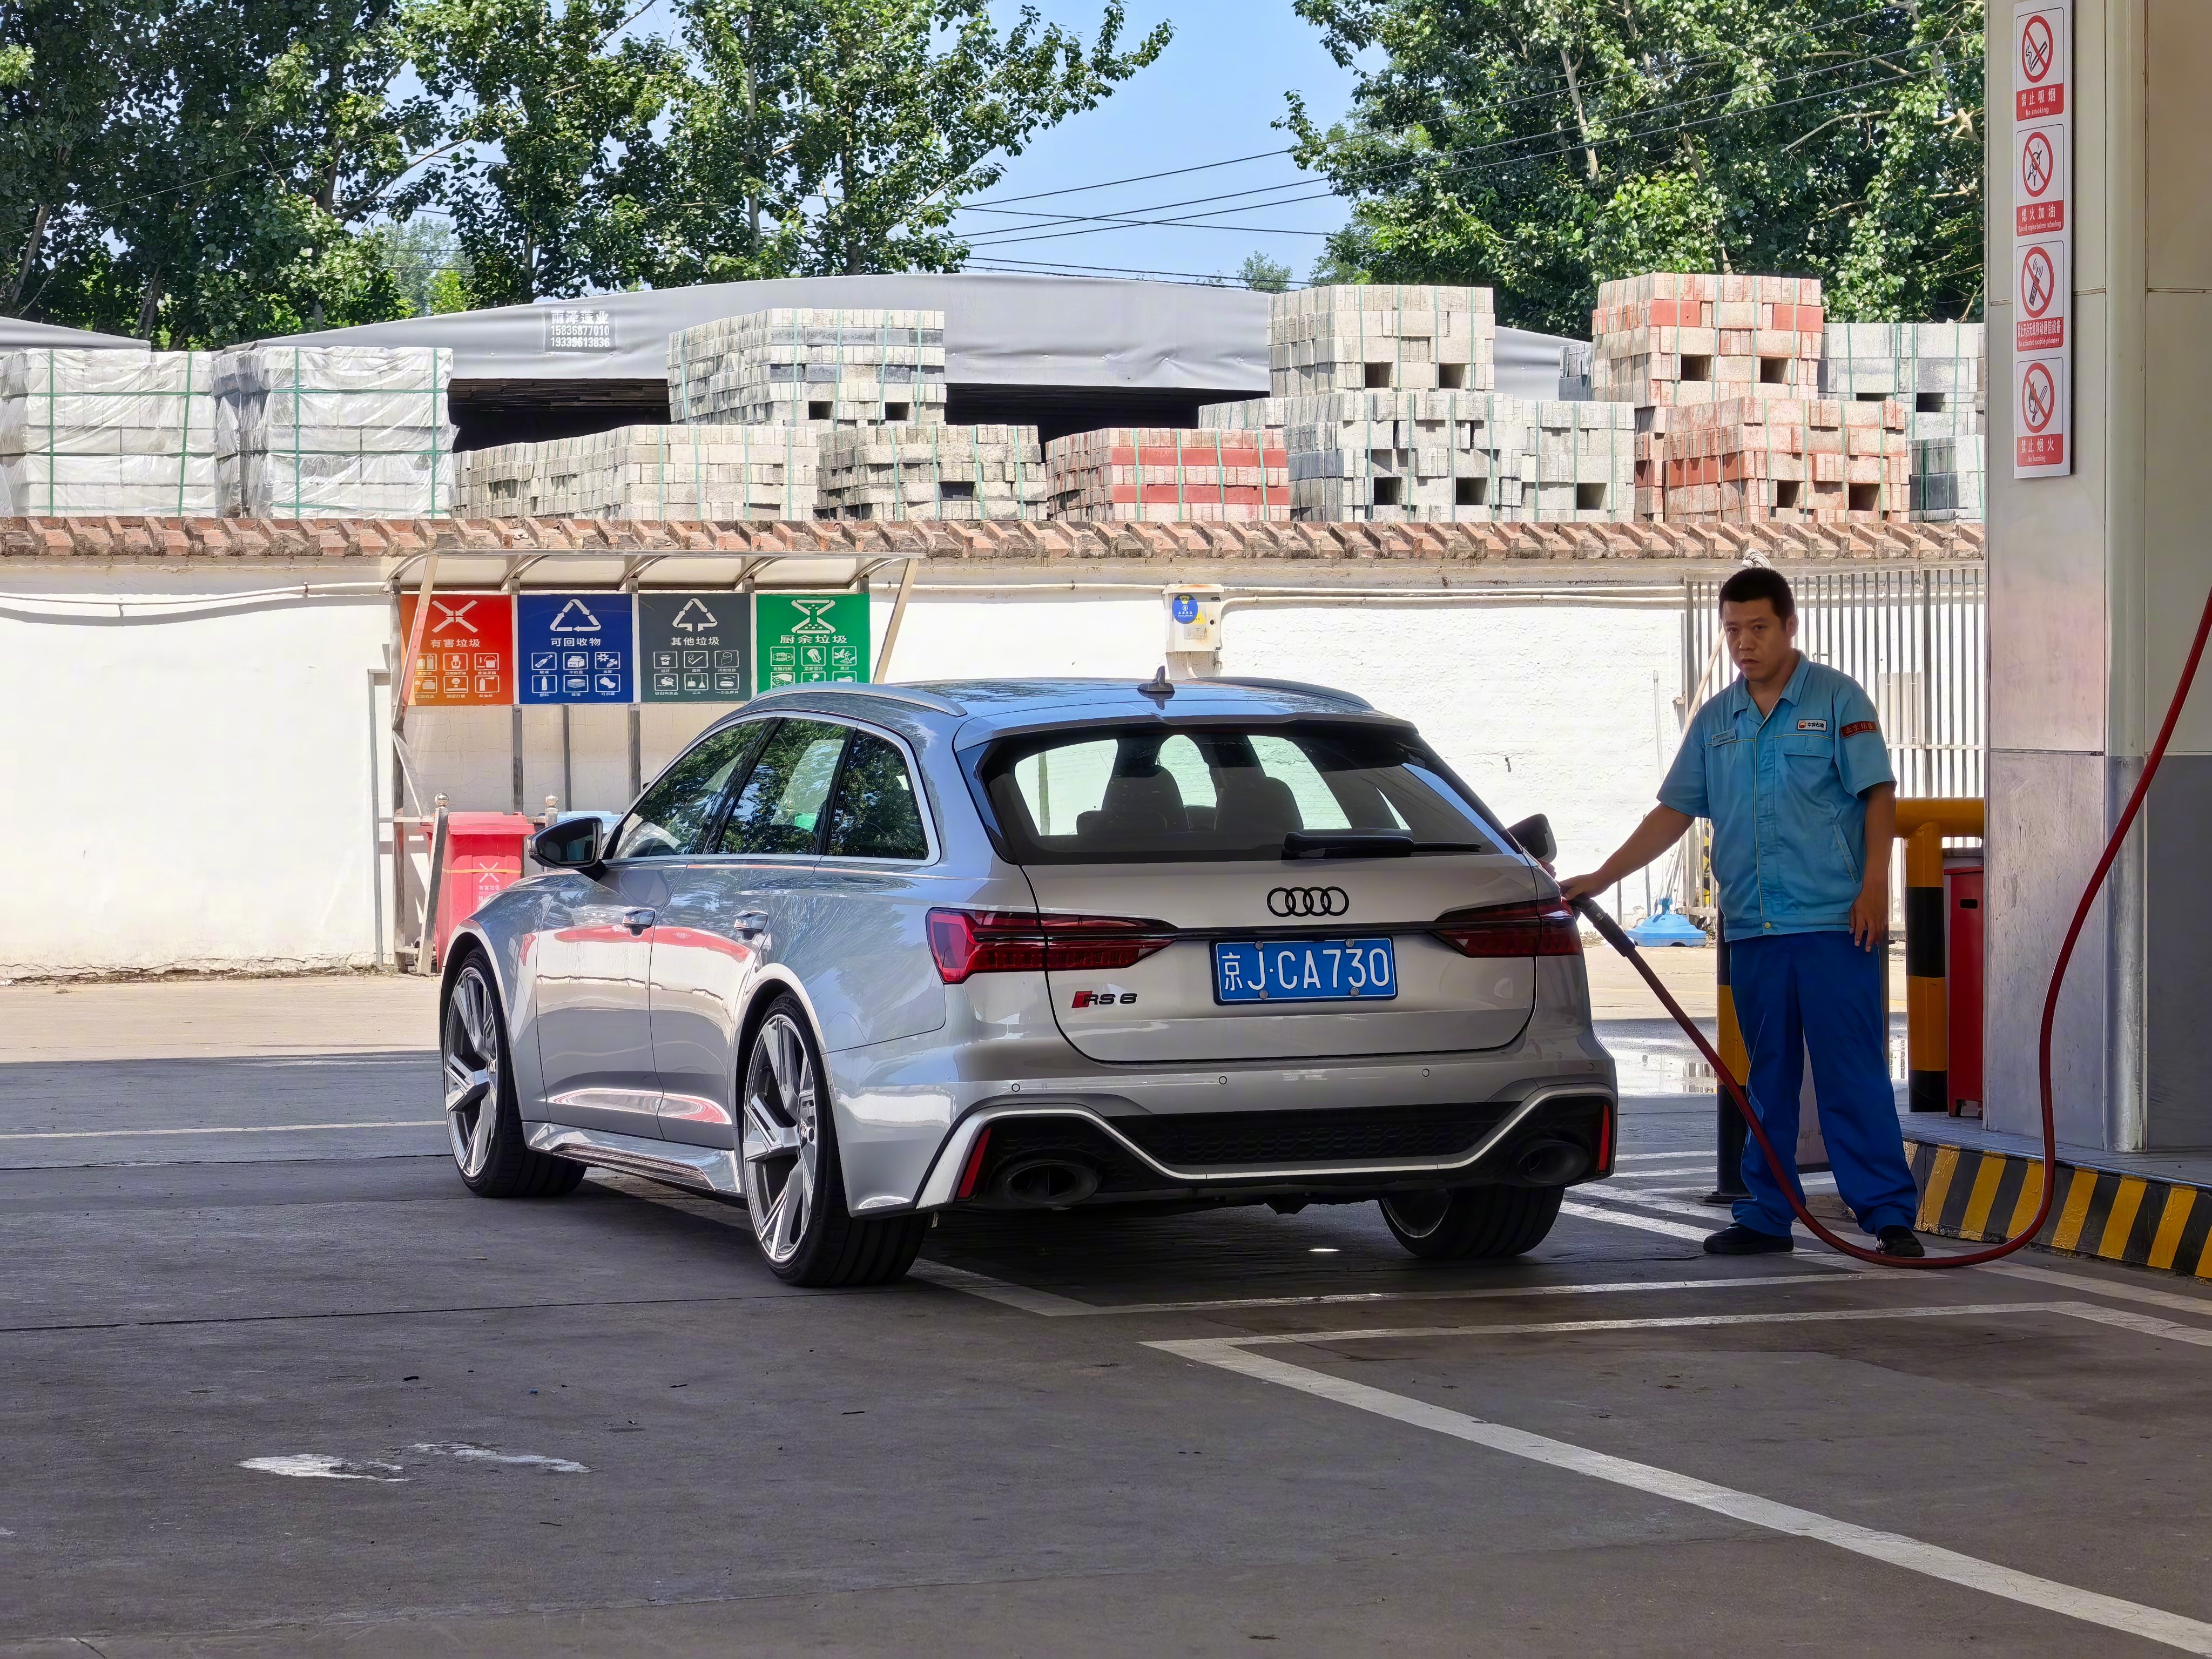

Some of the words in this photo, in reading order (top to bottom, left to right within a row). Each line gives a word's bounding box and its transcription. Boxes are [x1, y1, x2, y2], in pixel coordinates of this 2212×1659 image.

[2021, 88, 2055, 107] 禁止吸烟
[2032, 106, 2049, 115] smoking
[2021, 204, 2055, 222] 熄火加油
[551, 325, 610, 335] 15836877010
[430, 639, 481, 648] 有害垃圾
[550, 637, 601, 647] 可回收物
[671, 637, 720, 646] 其他垃圾
[779, 635, 847, 644] 厨余垃圾
[1222, 948, 1390, 991] 京J·CA730
